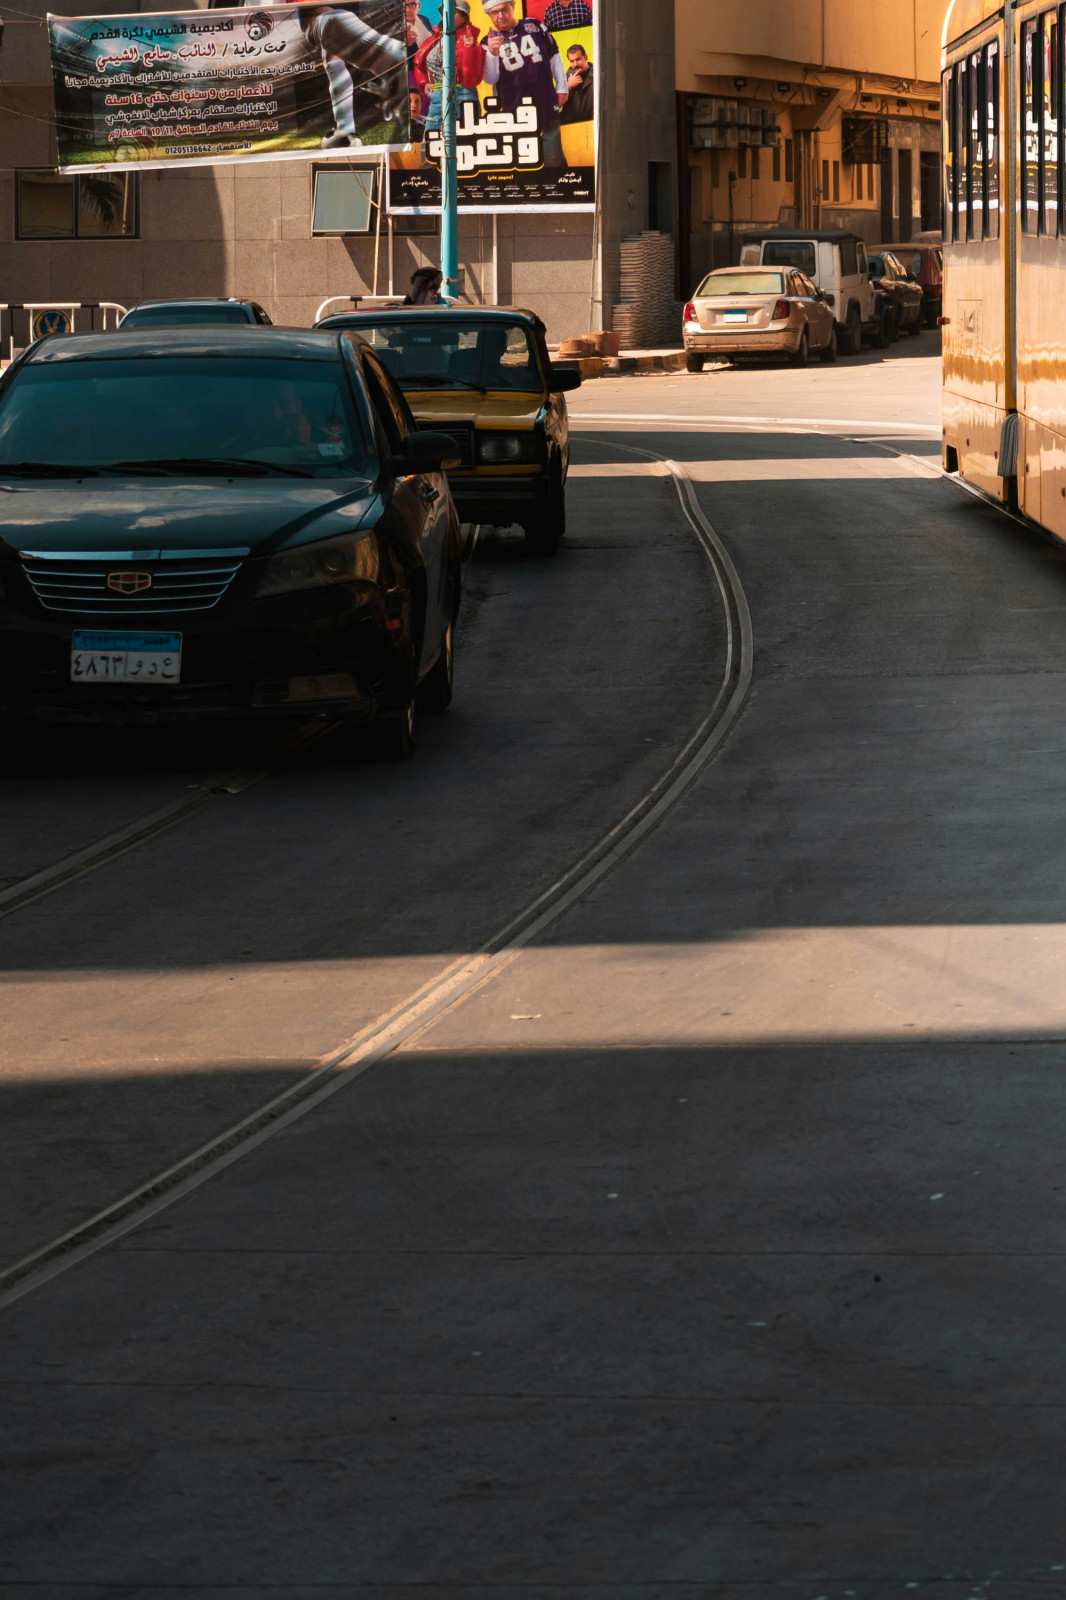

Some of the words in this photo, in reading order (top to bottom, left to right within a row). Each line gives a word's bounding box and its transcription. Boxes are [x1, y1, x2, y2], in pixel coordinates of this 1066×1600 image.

[122, 26, 144, 40] لكرة
[146, 24, 186, 40] الشيمي
[190, 19, 233, 36] أكاديمية
[90, 28, 120, 43] القدم
[178, 42, 216, 60] النائب
[234, 42, 262, 57] رعاية
[264, 41, 287, 52] تحت
[500, 34, 543, 72] 84
[96, 46, 138, 72] الشيمي
[144, 46, 170, 66] سامح
[174, 70, 218, 80] للمتقدمين
[261, 68, 276, 76] بدء
[278, 66, 292, 74] عن
[295, 63, 314, 73] تعلن
[171, 89, 207, 103] سنوات
[209, 88, 216, 99] 9
[218, 88, 235, 100] من
[237, 82, 273, 99] للأعمار
[105, 94, 130, 106] سنة
[130, 92, 142, 104] 16
[105, 110, 150, 126] الانفوشي
[151, 106, 177, 121] شباب
[178, 106, 201, 120] بمركز
[202, 104, 234, 119] ستقام
[456, 96, 538, 136] فضل
[122, 126, 146, 138] الساعة
[174, 124, 206, 137] الموافق
[207, 122, 234, 135] القادم
[260, 120, 278, 132] يوم
